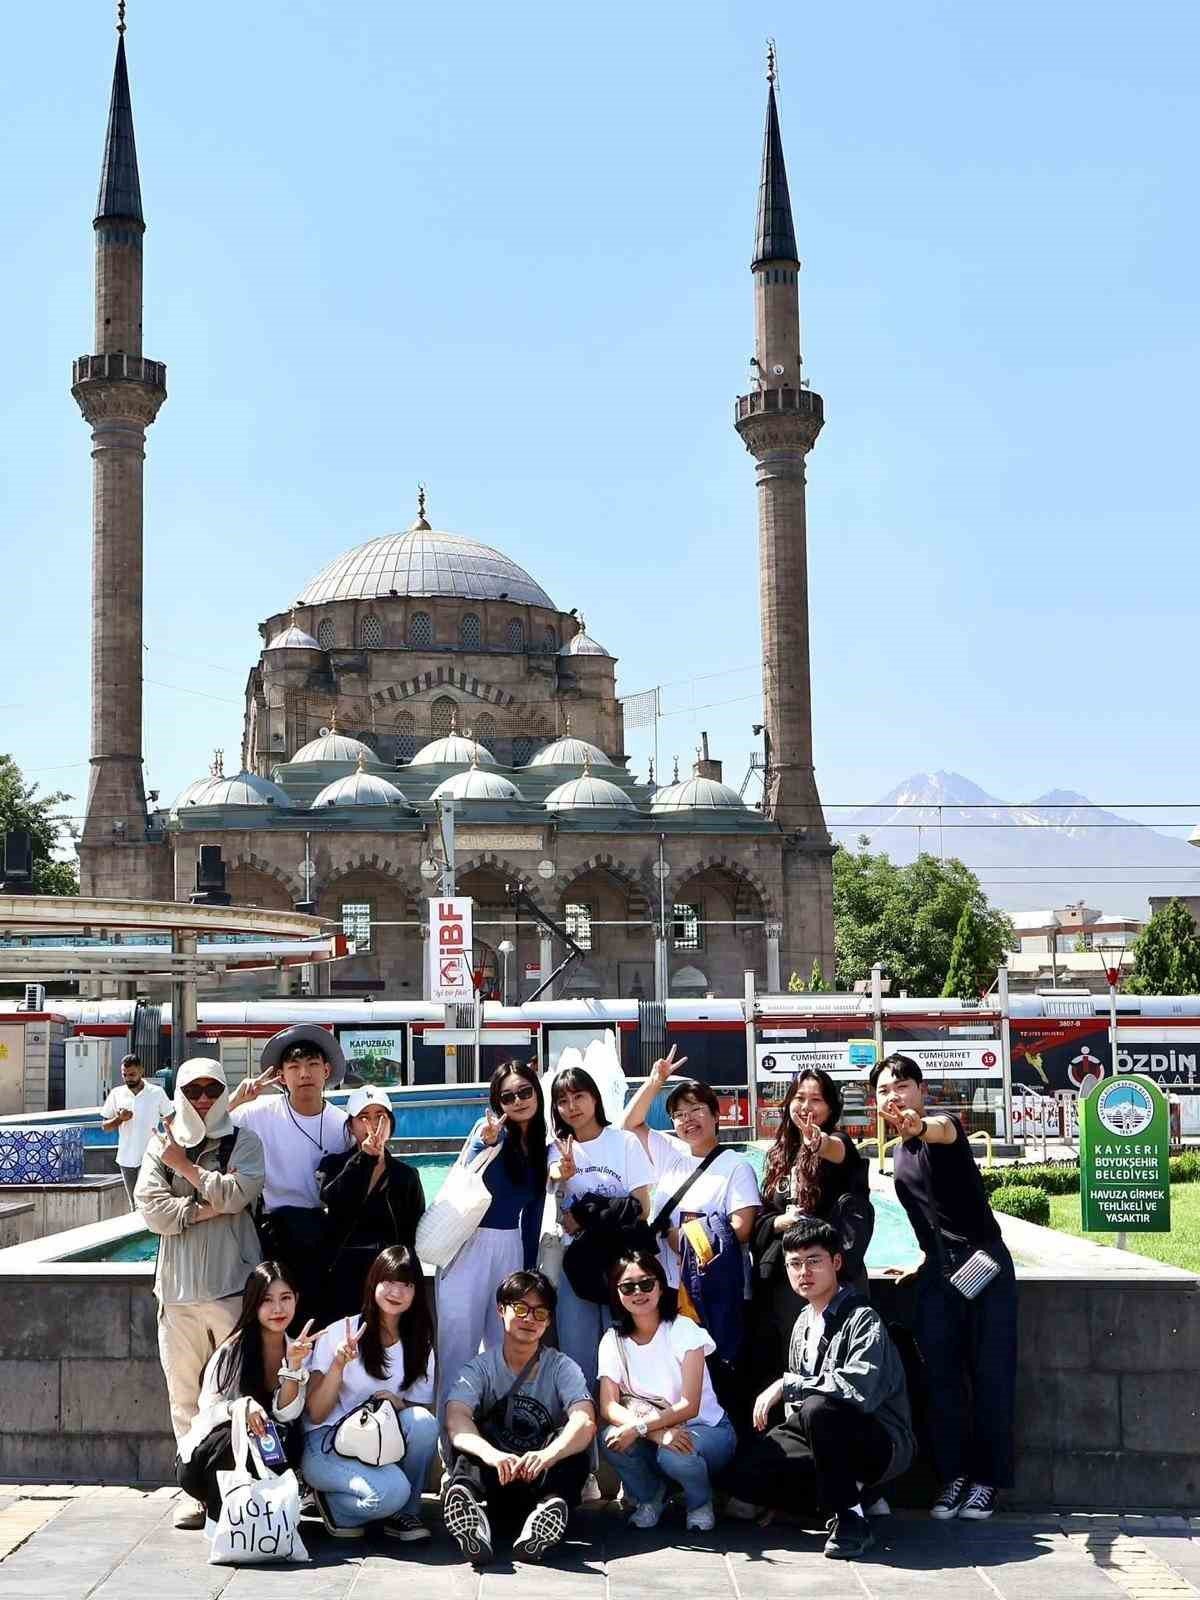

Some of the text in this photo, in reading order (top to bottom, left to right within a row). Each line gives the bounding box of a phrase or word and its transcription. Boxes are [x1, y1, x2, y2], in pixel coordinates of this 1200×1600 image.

[763, 1057, 774, 1067] 19
[984, 1055, 994, 1064] 19
[1090, 1188, 1165, 1199] HAVUZA GİRMEK
[1098, 1200, 1157, 1211] TEHLİKELİ VE
[1105, 1213, 1150, 1223] YASAKTIR
